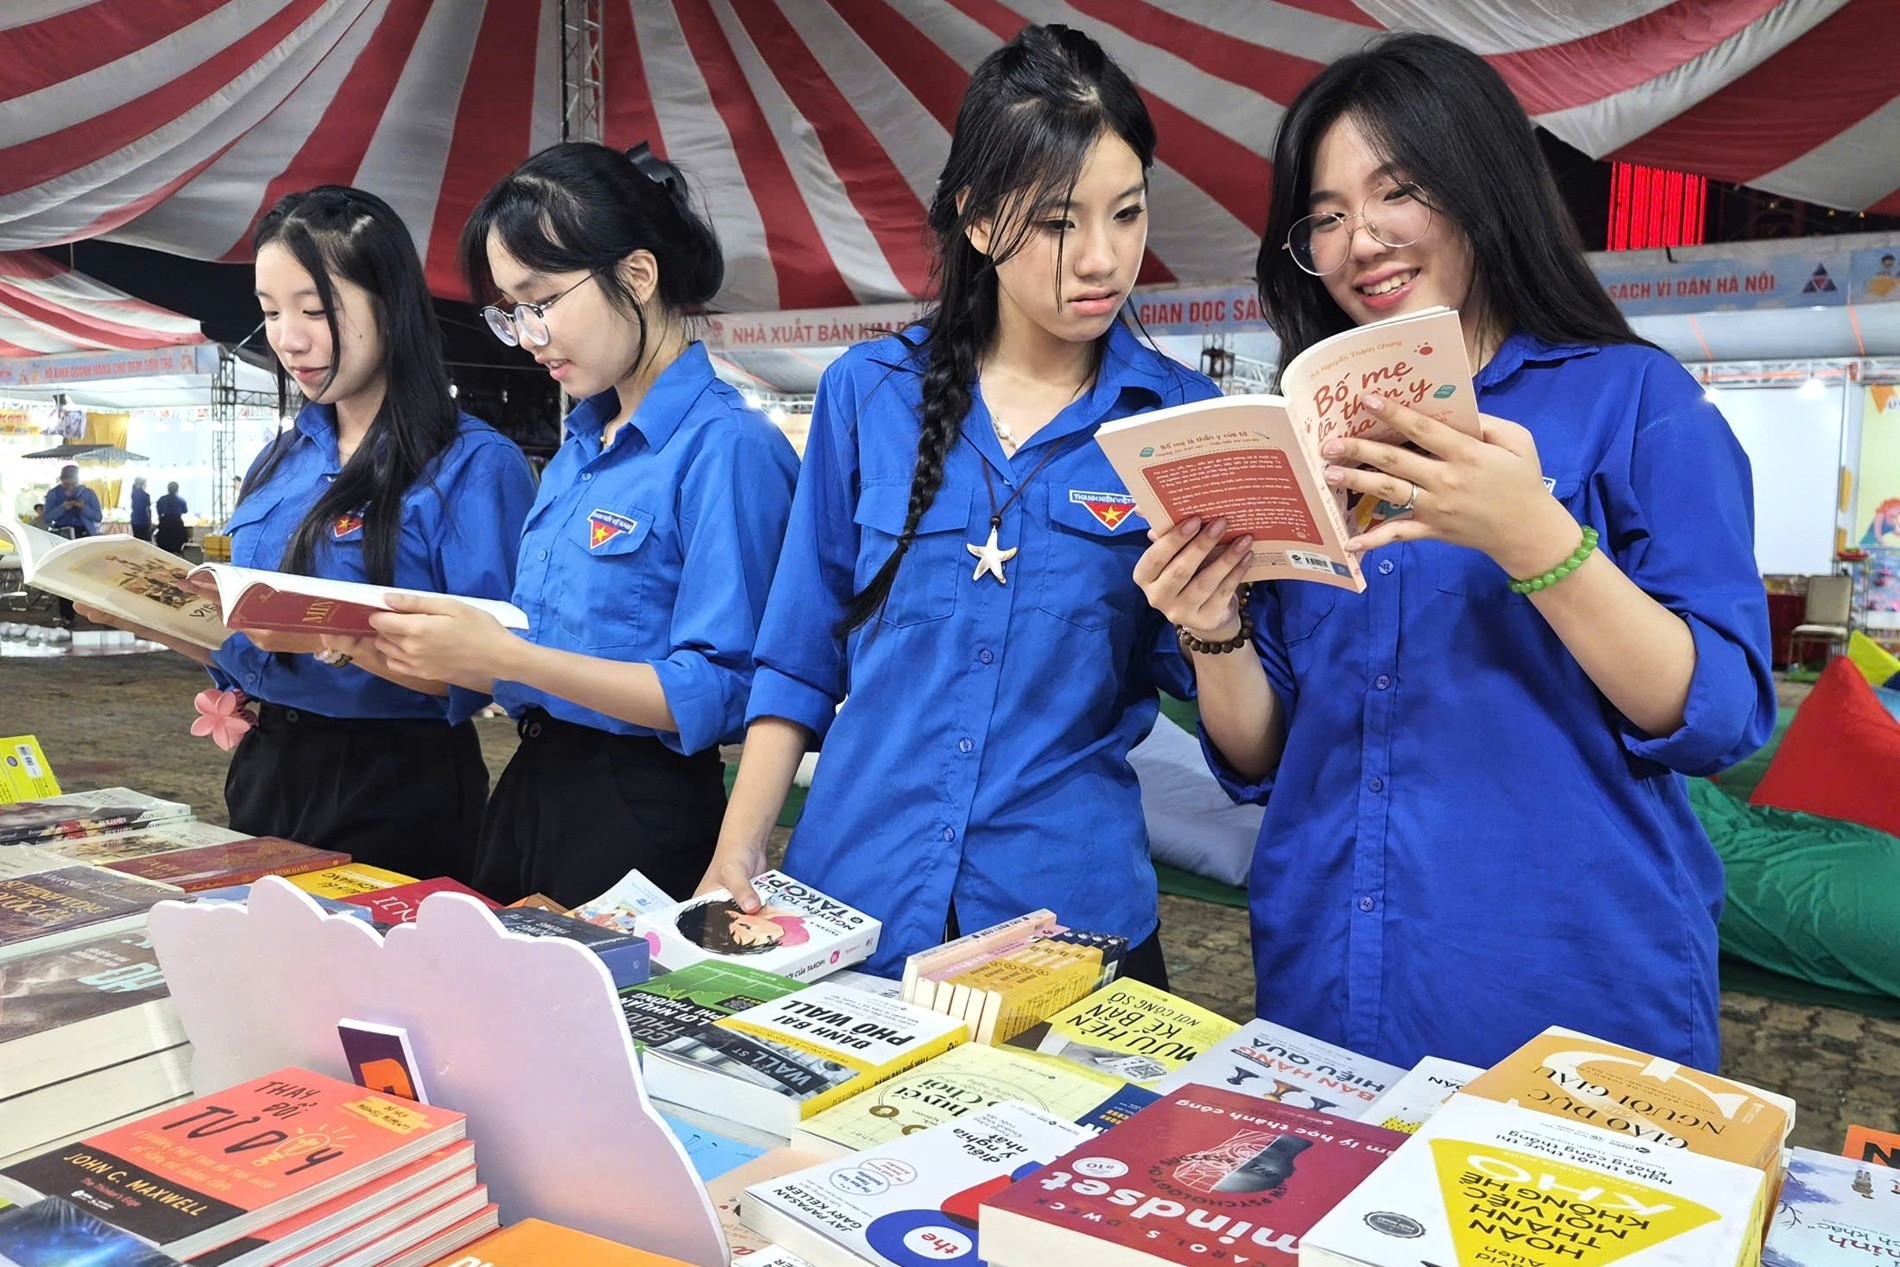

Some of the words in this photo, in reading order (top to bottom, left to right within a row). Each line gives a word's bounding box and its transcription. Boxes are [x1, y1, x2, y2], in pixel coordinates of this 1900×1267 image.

[1716, 271, 1739, 293] HÀ
[1745, 270, 1775, 295] NỘI
[1140, 302, 1182, 326] GIAN
[1189, 300, 1226, 328] ĐỌC
[1233, 294, 1265, 321] SÁ
[732, 321, 765, 345] NHÀ
[771, 317, 814, 344] XUẤT
[818, 318, 854, 342] BẢN
[1313, 372, 1351, 419] Bố
[1361, 361, 1414, 390] mẹ
[1317, 417, 1338, 444] là
[1340, 386, 1404, 421] thn
[1409, 378, 1434, 404] y
[1160, 442, 1171, 450] Bố
[1173, 440, 1186, 449] mẹ
[802, 905, 856, 931] NGUYÊN
[1107, 992, 1136, 1006] SỞ
[1134, 999, 1175, 1018] CÔNG
[695, 1008, 726, 1020] PHI
[771, 1015, 814, 1030] BẠI
[781, 999, 853, 1027] WALL
[809, 1026, 872, 1050] ĐÁNH
[841, 1023, 916, 1047] PHỐ
[731, 1047, 750, 1057] ST
[1239, 1045, 1312, 1080] HÀNG
[1252, 1037, 1310, 1065] QUẢ
[752, 1049, 812, 1087] WALL
[1315, 1065, 1386, 1093] HIỆU
[254, 1080, 321, 1100] THAY
[917, 1078, 983, 1104] Chơi
[1317, 1077, 1376, 1101] BÁN
[1533, 1066, 1610, 1097] GIÀU
[891, 1087, 970, 1118] huyết
[1174, 1099, 1225, 1115] công
[1527, 1089, 1598, 1120] DỤC
[161, 1105, 262, 1140] TƯ
[1229, 1110, 1290, 1131] thành
[1619, 1095, 1726, 1135] NGƯỜI
[952, 1128, 1000, 1152] nghĩa
[989, 1134, 1028, 1154] nhất
[1293, 1125, 1335, 1140] học
[1338, 1134, 1358, 1149] lý
[1496, 1134, 1519, 1144] thi
[1509, 1130, 1558, 1150] thẳng
[1366, 1143, 1400, 1159] âm
[1523, 1141, 1564, 1157] thực
[1563, 1146, 1607, 1161] căng
[1569, 1154, 1619, 1171] thuật
[1611, 1158, 1667, 1178] không
[63, 1153, 114, 1174] JOHN
[106, 1170, 128, 1183] C.
[125, 1180, 208, 1217] MAXWELL
[1459, 1171, 1510, 1191] HỀ
[1625, 1169, 1673, 1185] Nghệ
[773, 1188, 829, 1222] PAPASAN
[785, 1184, 829, 1214] KELLER
[1463, 1186, 1544, 1218] VIỆC
[1517, 1188, 1650, 1230] KHÔNG
[829, 1208, 863, 1231] GARY
[1040, 1171, 1301, 1254] mindset
[827, 1218, 854, 1232] JAY
[1469, 1203, 1602, 1249] THÀNH
[1555, 1213, 1628, 1239] MỌI
[920, 1232, 959, 1255] the
[1469, 1219, 1585, 1260] HOÀN
[1484, 1245, 1546, 1267] Allen
